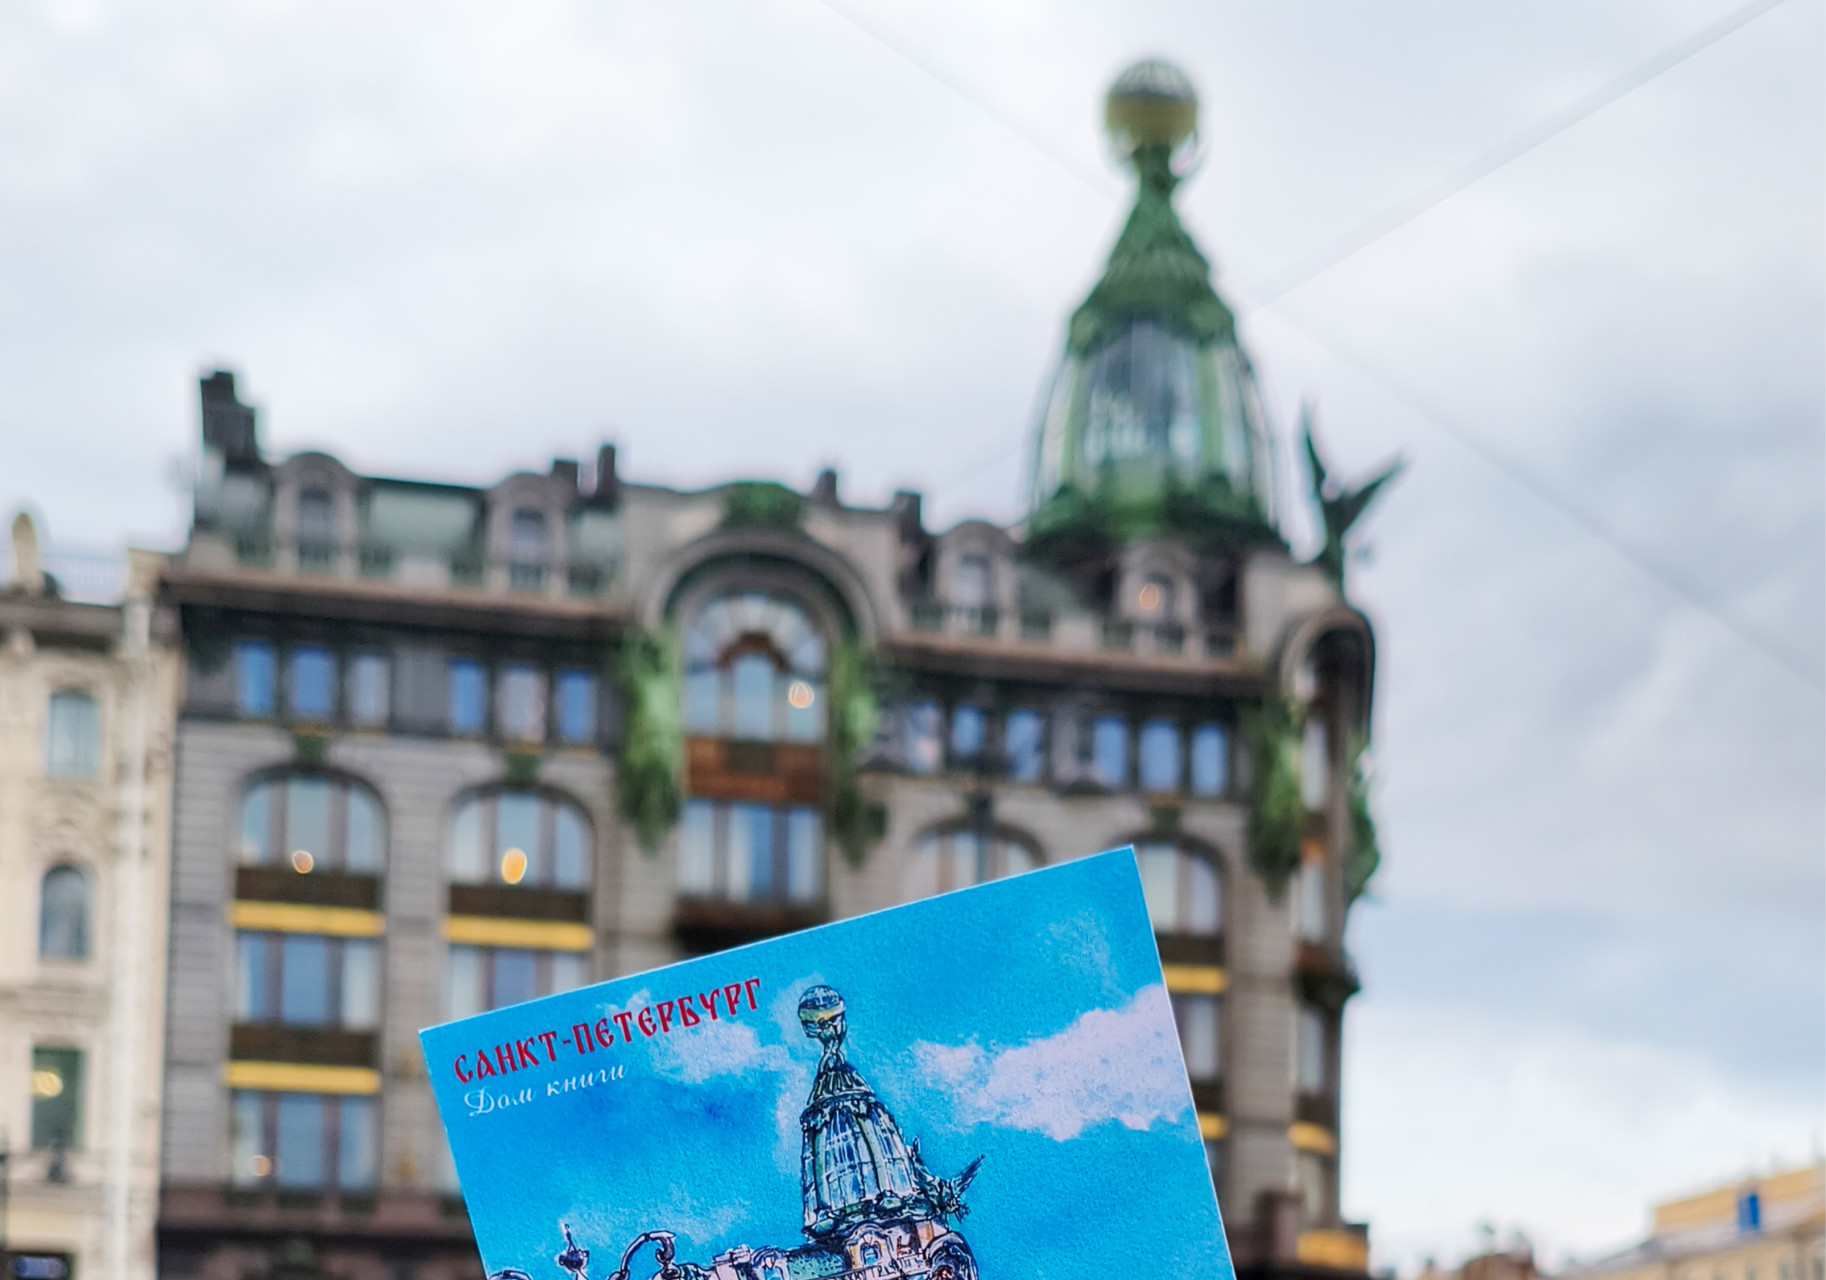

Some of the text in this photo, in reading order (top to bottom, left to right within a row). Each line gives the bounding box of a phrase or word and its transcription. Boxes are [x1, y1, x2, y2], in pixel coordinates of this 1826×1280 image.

[453, 978, 761, 1084] САНКТ-ПЕТЕРБУРГ
[463, 1062, 629, 1117] Дом книги
